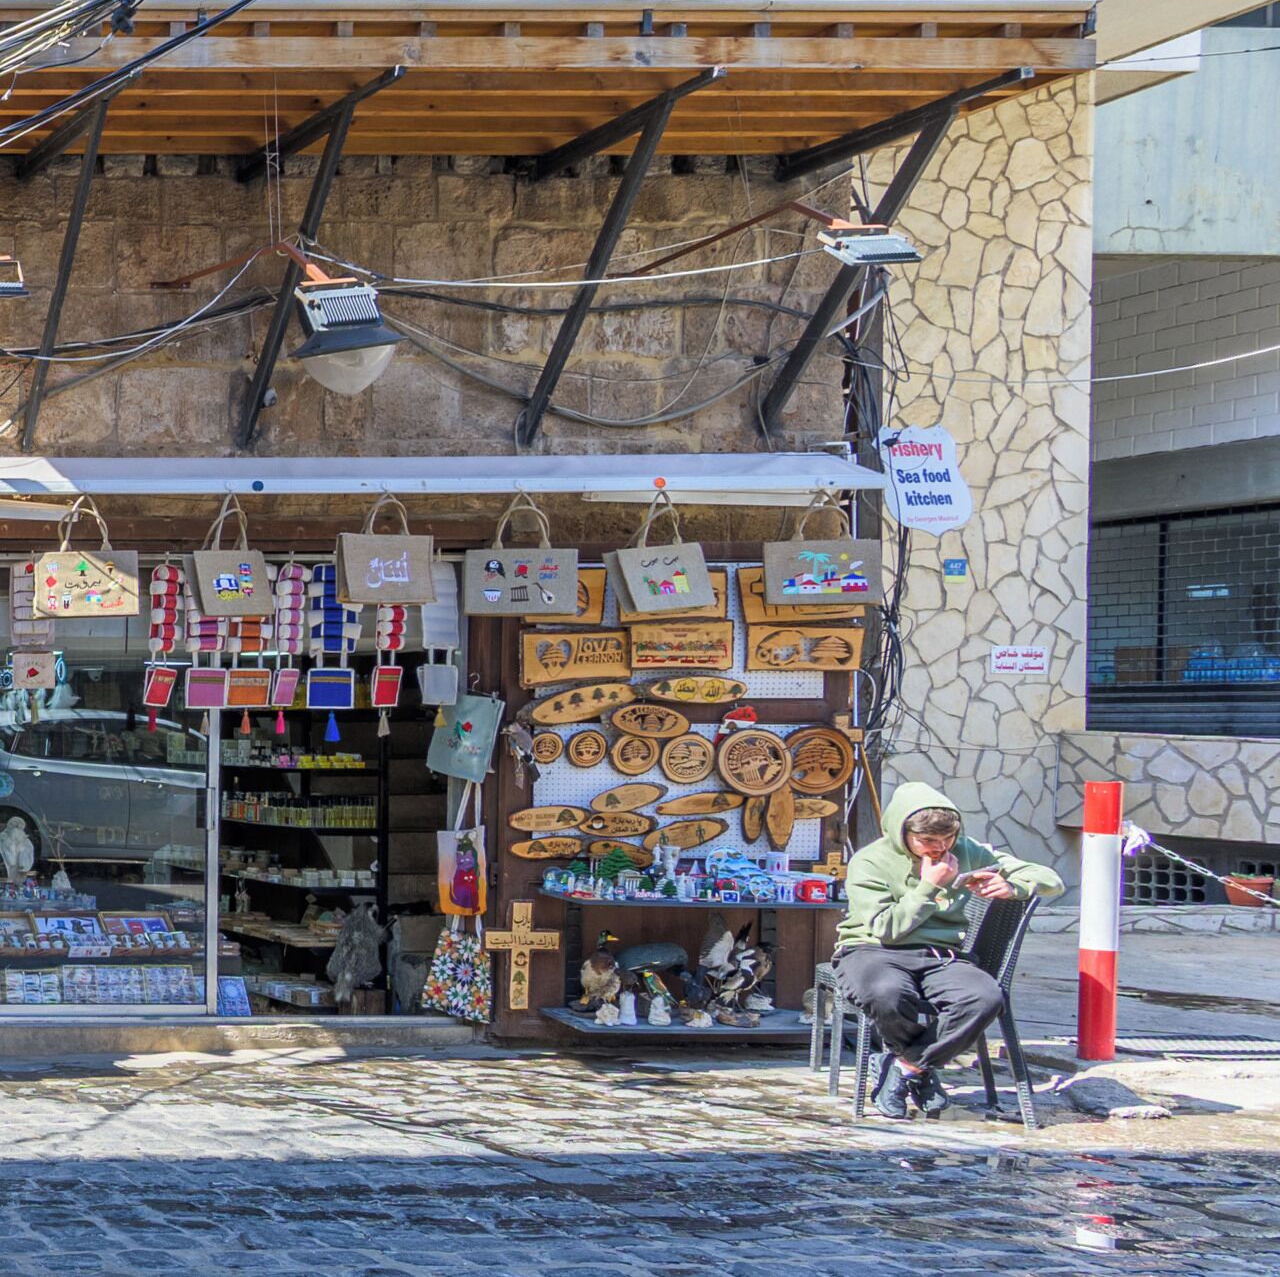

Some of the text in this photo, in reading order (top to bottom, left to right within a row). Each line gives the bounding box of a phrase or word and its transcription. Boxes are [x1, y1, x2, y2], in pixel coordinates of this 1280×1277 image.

[896, 467, 951, 484] Sea food
[905, 489, 952, 506] kitchen
